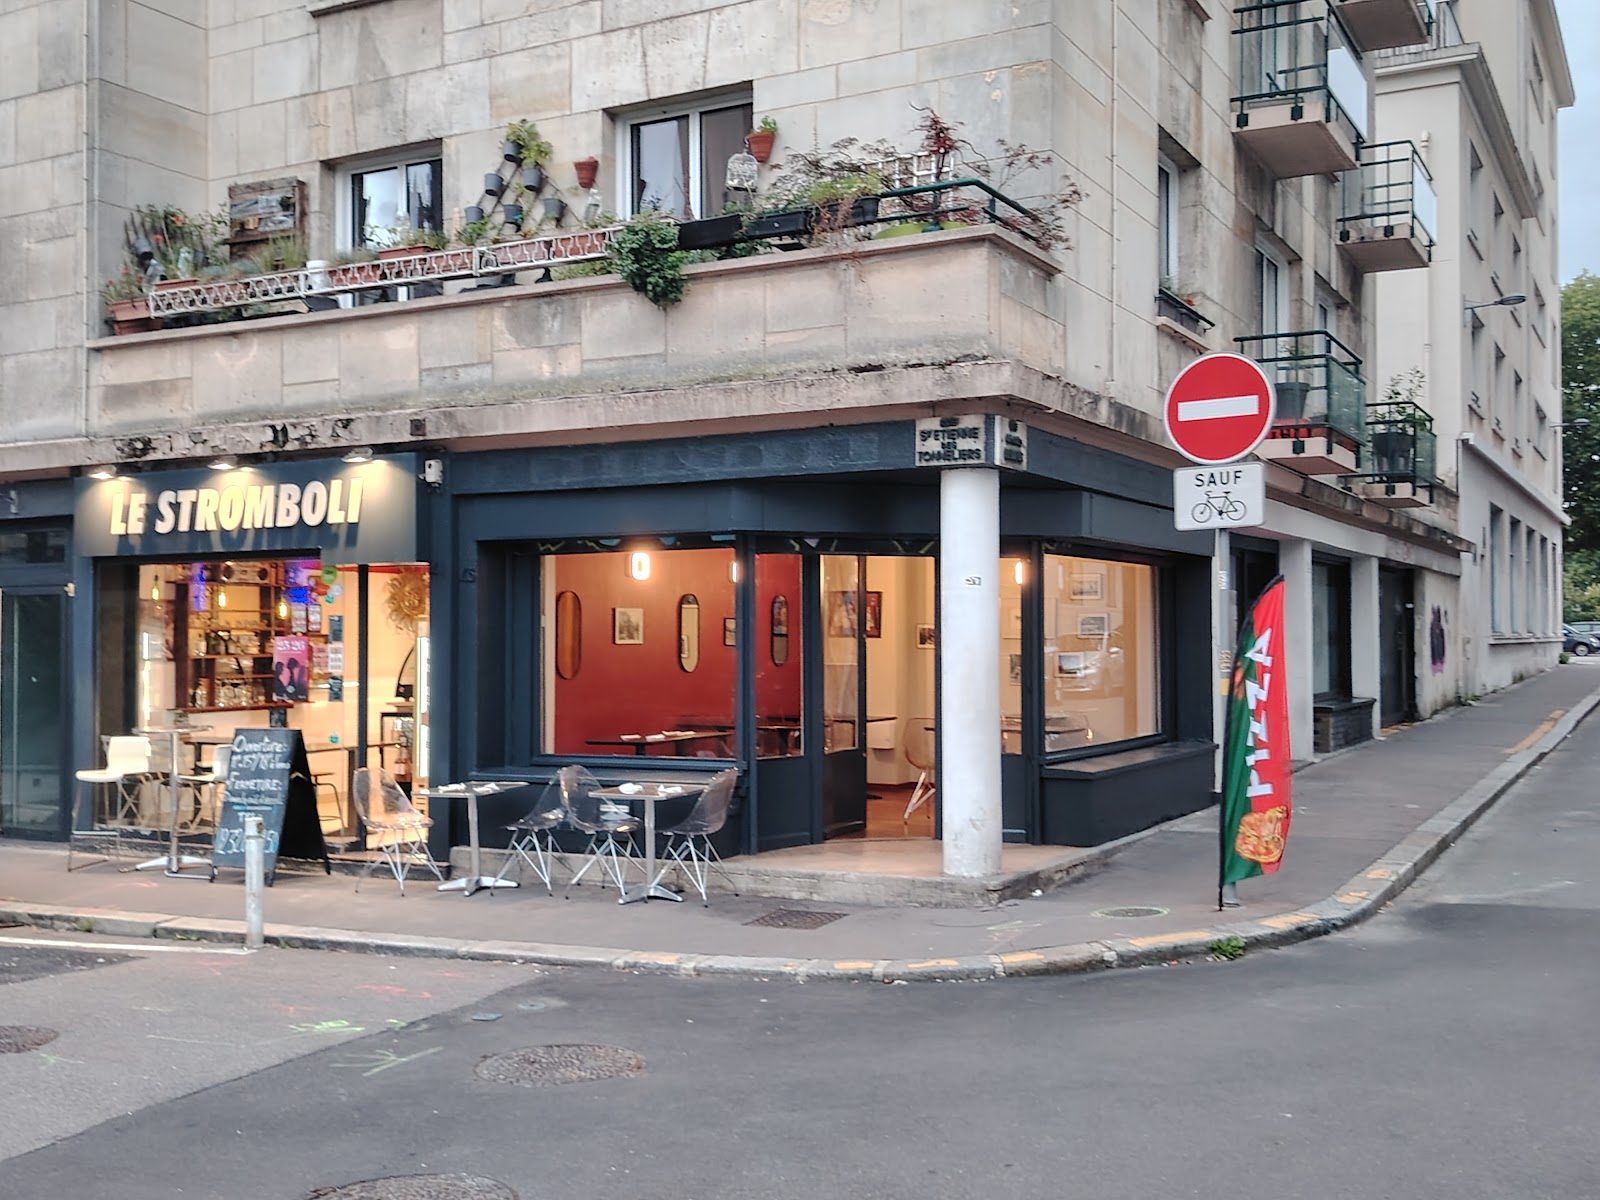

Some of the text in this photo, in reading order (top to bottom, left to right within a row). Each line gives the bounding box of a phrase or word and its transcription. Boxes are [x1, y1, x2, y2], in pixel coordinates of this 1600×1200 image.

[110, 478, 364, 535] LE STROMBOLI
[1194, 470, 1242, 487] SAUF
[1244, 628, 1274, 797] PIZZA
